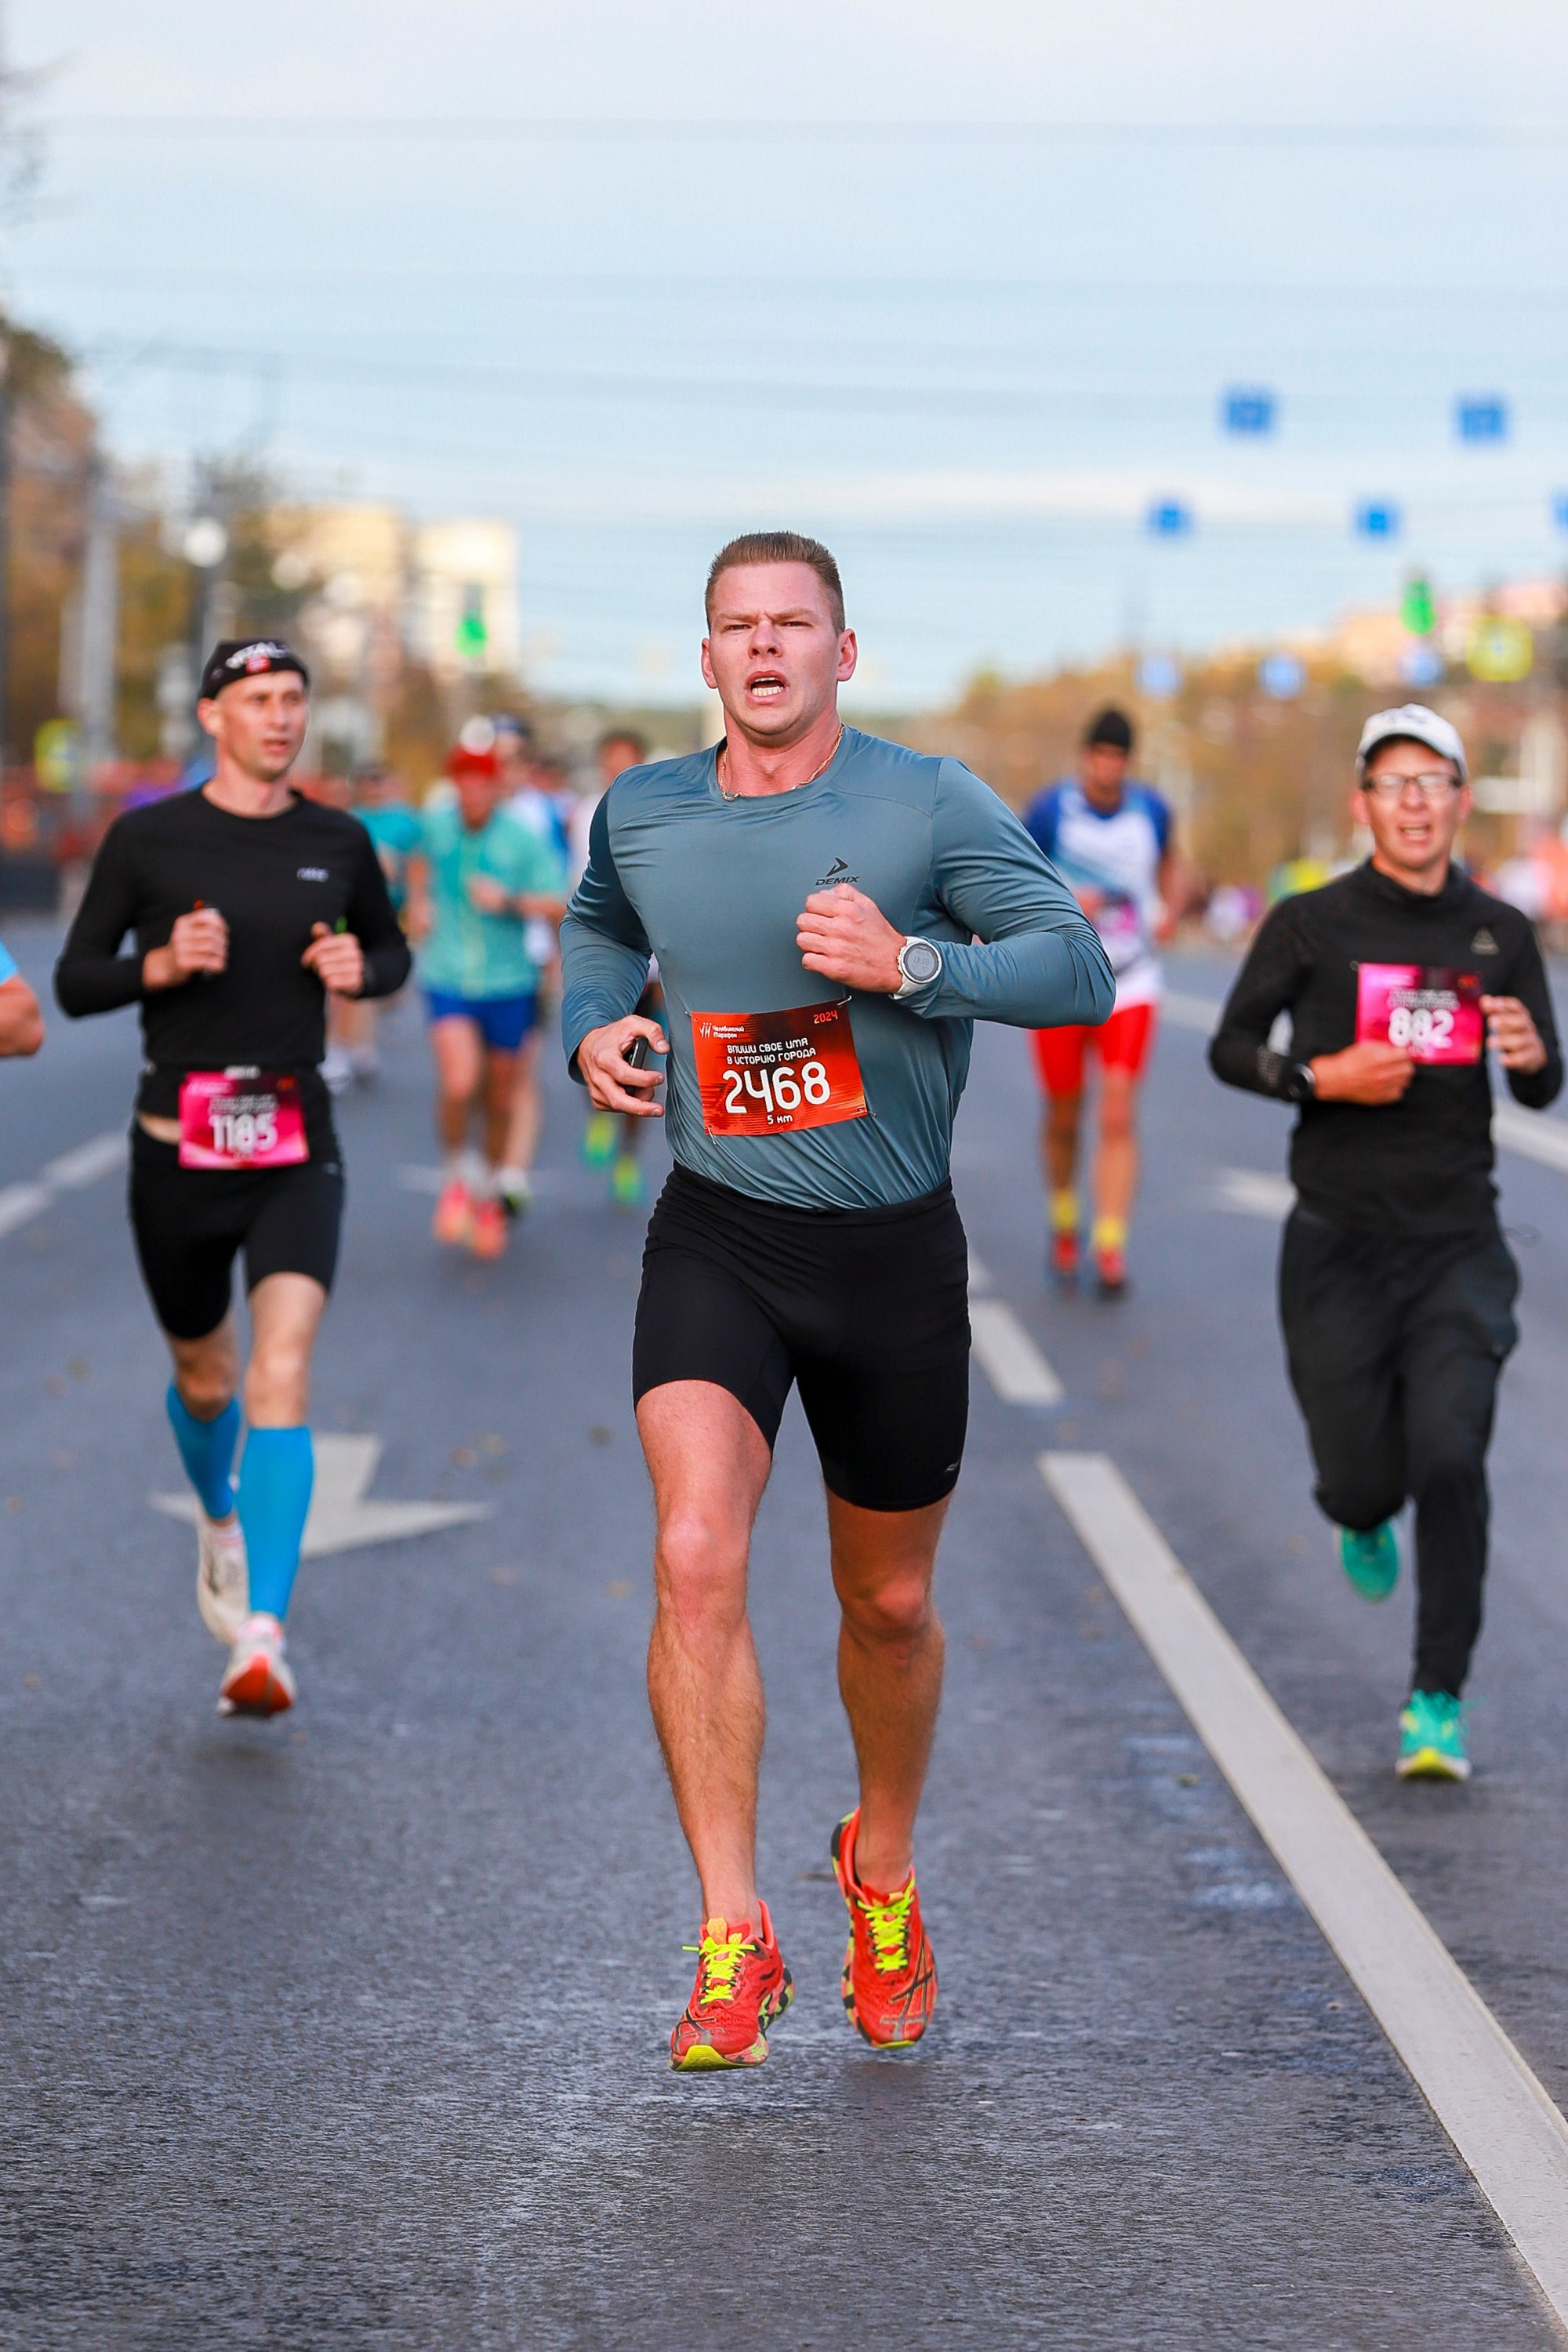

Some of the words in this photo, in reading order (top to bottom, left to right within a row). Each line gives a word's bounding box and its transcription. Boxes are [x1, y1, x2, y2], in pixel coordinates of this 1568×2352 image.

[815, 876, 860, 886] DEMIX
[814, 1011, 838, 1024] 2024
[1388, 1007, 1454, 1049] 882
[727, 1044, 757, 1054] ВПИШИ
[758, 1042, 783, 1053] СВОЕ
[785, 1037, 808, 1049] ИМЯ
[727, 1056, 733, 1065] В
[734, 1054, 776, 1065] ИСТОРИЮ
[778, 1047, 816, 1062] ГОРОДА
[722, 1061, 831, 1114] 2468
[767, 1114, 774, 1125] 5
[209, 1113, 278, 1154] 1185
